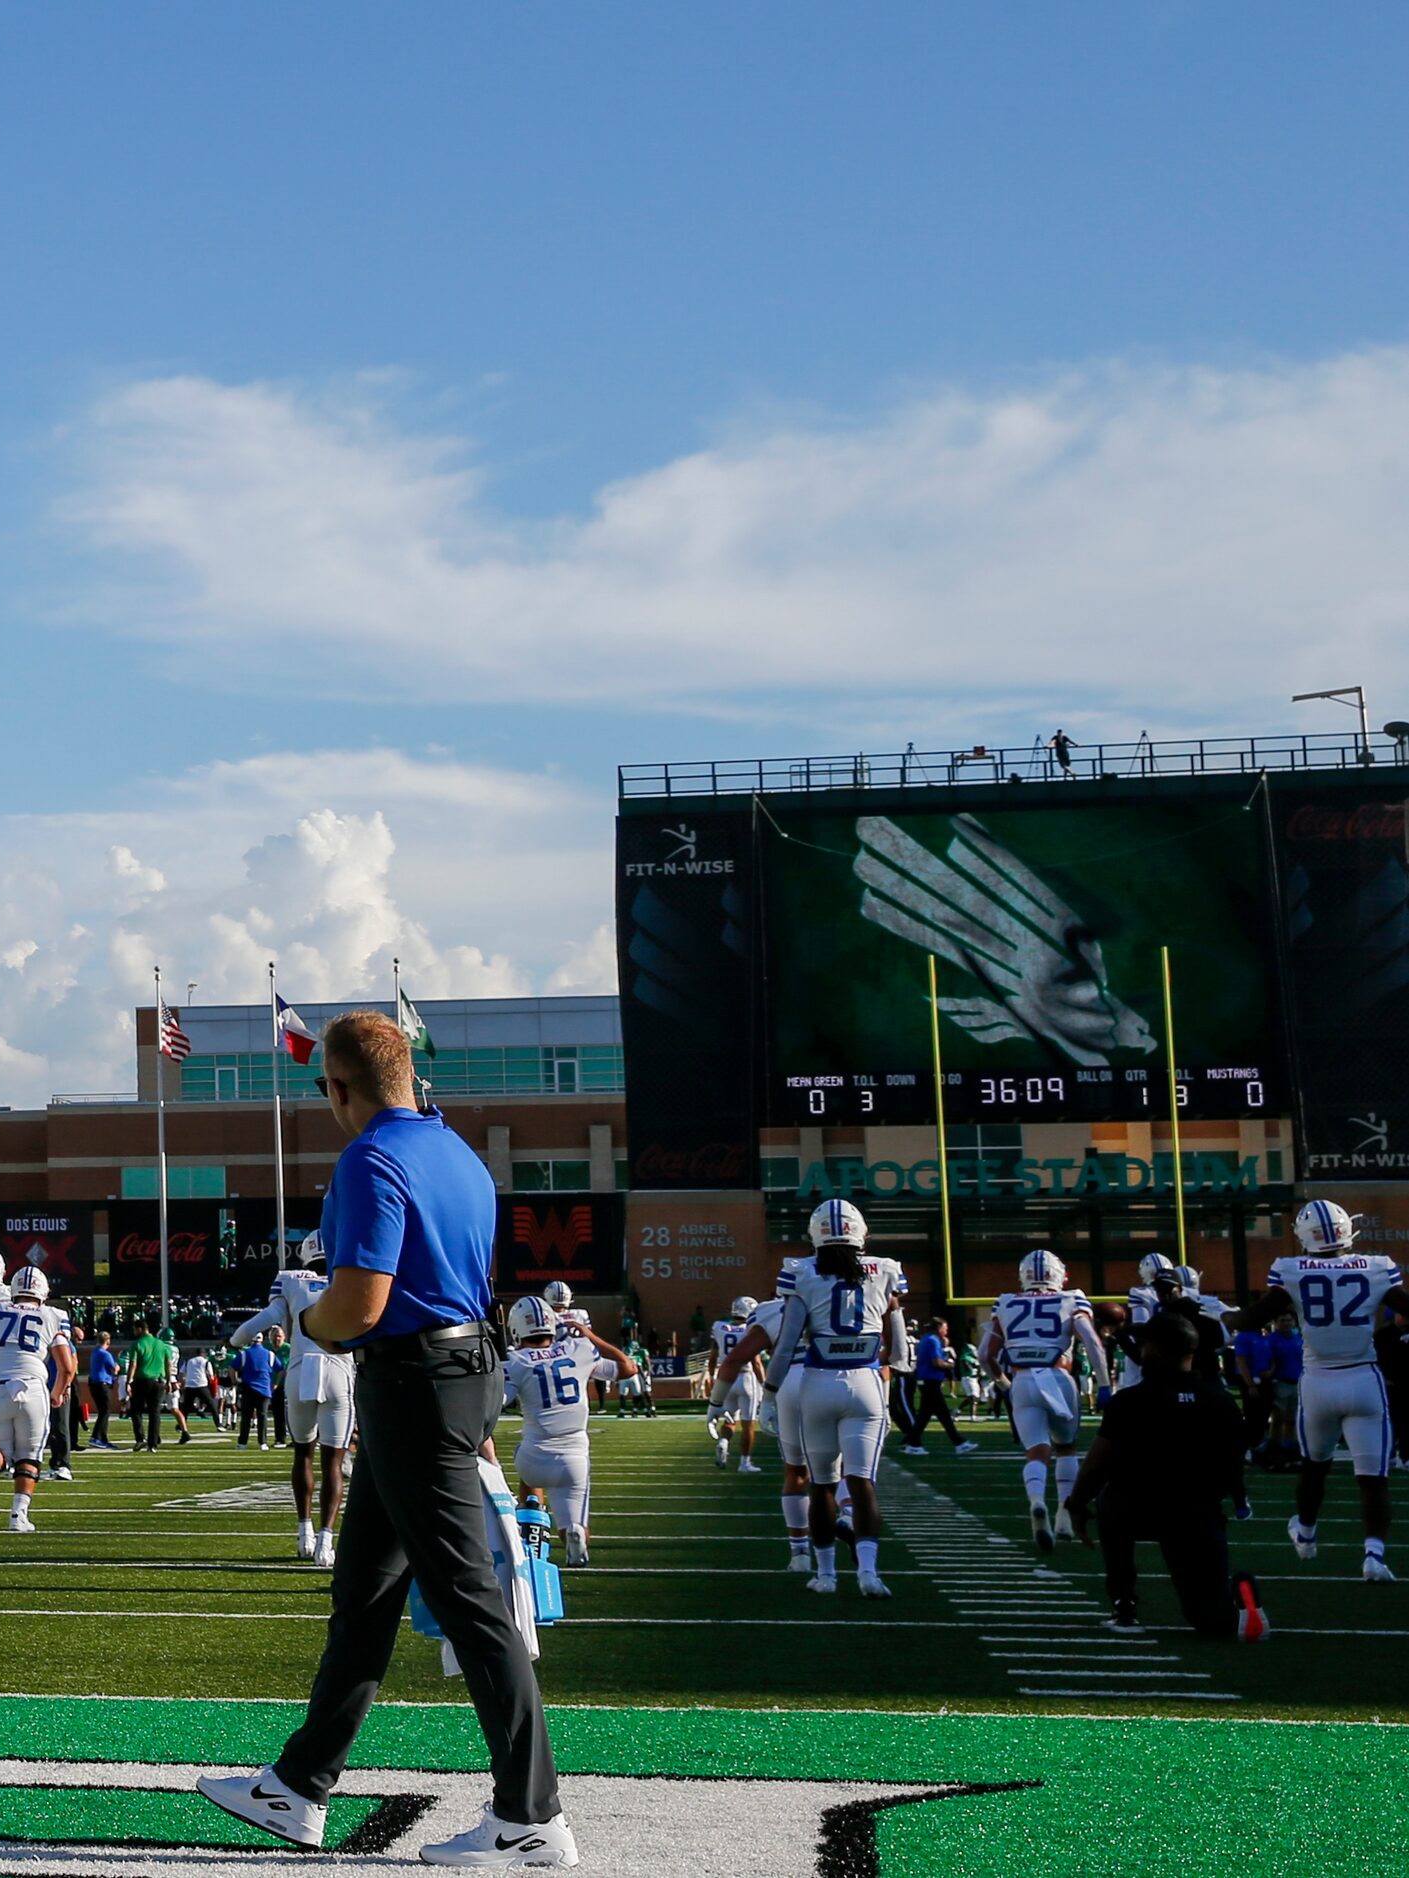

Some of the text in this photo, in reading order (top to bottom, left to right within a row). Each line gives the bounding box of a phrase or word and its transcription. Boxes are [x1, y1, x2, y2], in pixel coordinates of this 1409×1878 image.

[625, 860, 734, 876] FIT-N-WISE
[787, 1076, 843, 1087] MEAN GREEN
[886, 1074, 916, 1085] DOWN
[1125, 1069, 1148, 1081] QTR
[1207, 1068, 1259, 1079] MUSTANGS
[981, 1078, 1064, 1103] 36:09
[1247, 1081, 1263, 1106] 0
[809, 1090, 825, 1114] 0
[861, 1091, 873, 1111] 3
[795, 1155, 1260, 1198] APOGEE STADIUM
[6, 1218, 68, 1232] DOS EQUIS
[640, 1224, 729, 1247] 28 ABNER
[679, 1237, 736, 1248] HAYNES
[116, 1233, 210, 1263] CocaCola
[641, 1256, 746, 1278] 55 RICHARD
[680, 1269, 712, 1280] GILL
[830, 1281, 864, 1334] 0
[1299, 1274, 1370, 1326] 82
[1006, 1298, 1062, 1340] 25
[529, 1345, 567, 1361] EASLEY
[829, 1343, 867, 1354] DOUGLAS
[533, 1358, 579, 1408] 16
[1178, 1392, 1196, 1402] 214
